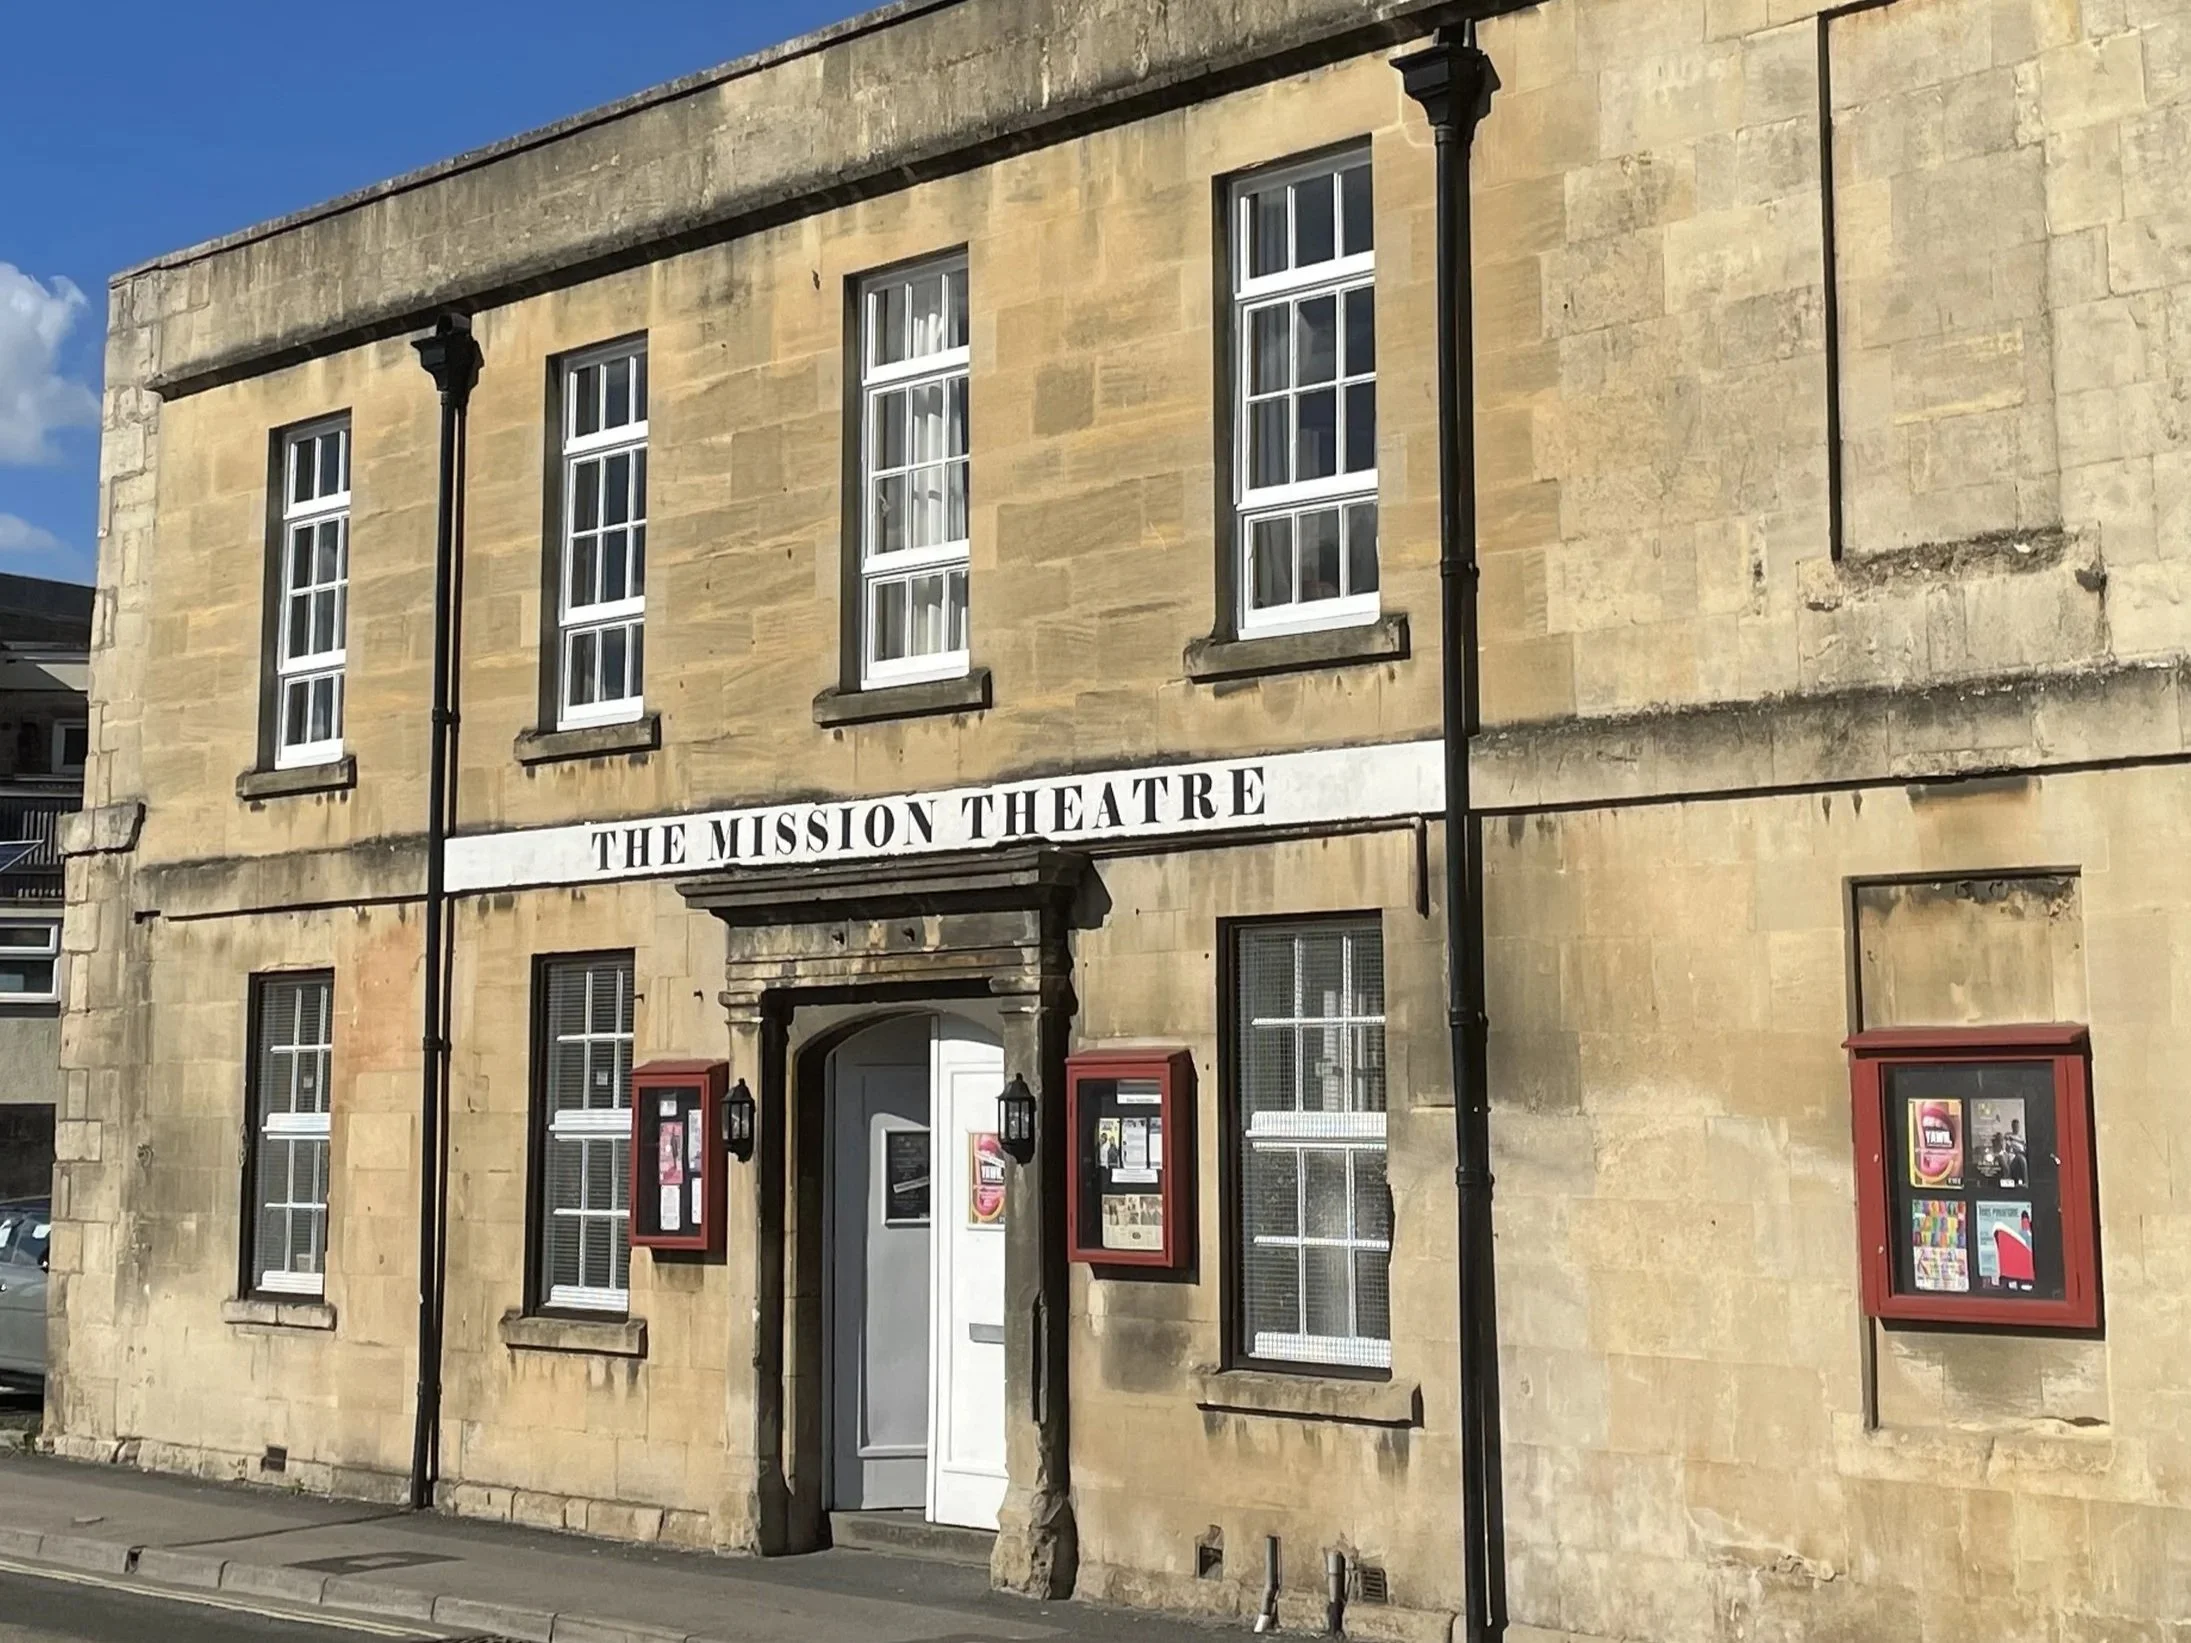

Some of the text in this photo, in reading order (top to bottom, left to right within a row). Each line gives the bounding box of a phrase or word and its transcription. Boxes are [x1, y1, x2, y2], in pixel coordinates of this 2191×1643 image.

[591, 766, 1266, 872] THE MISSION THEATRE
